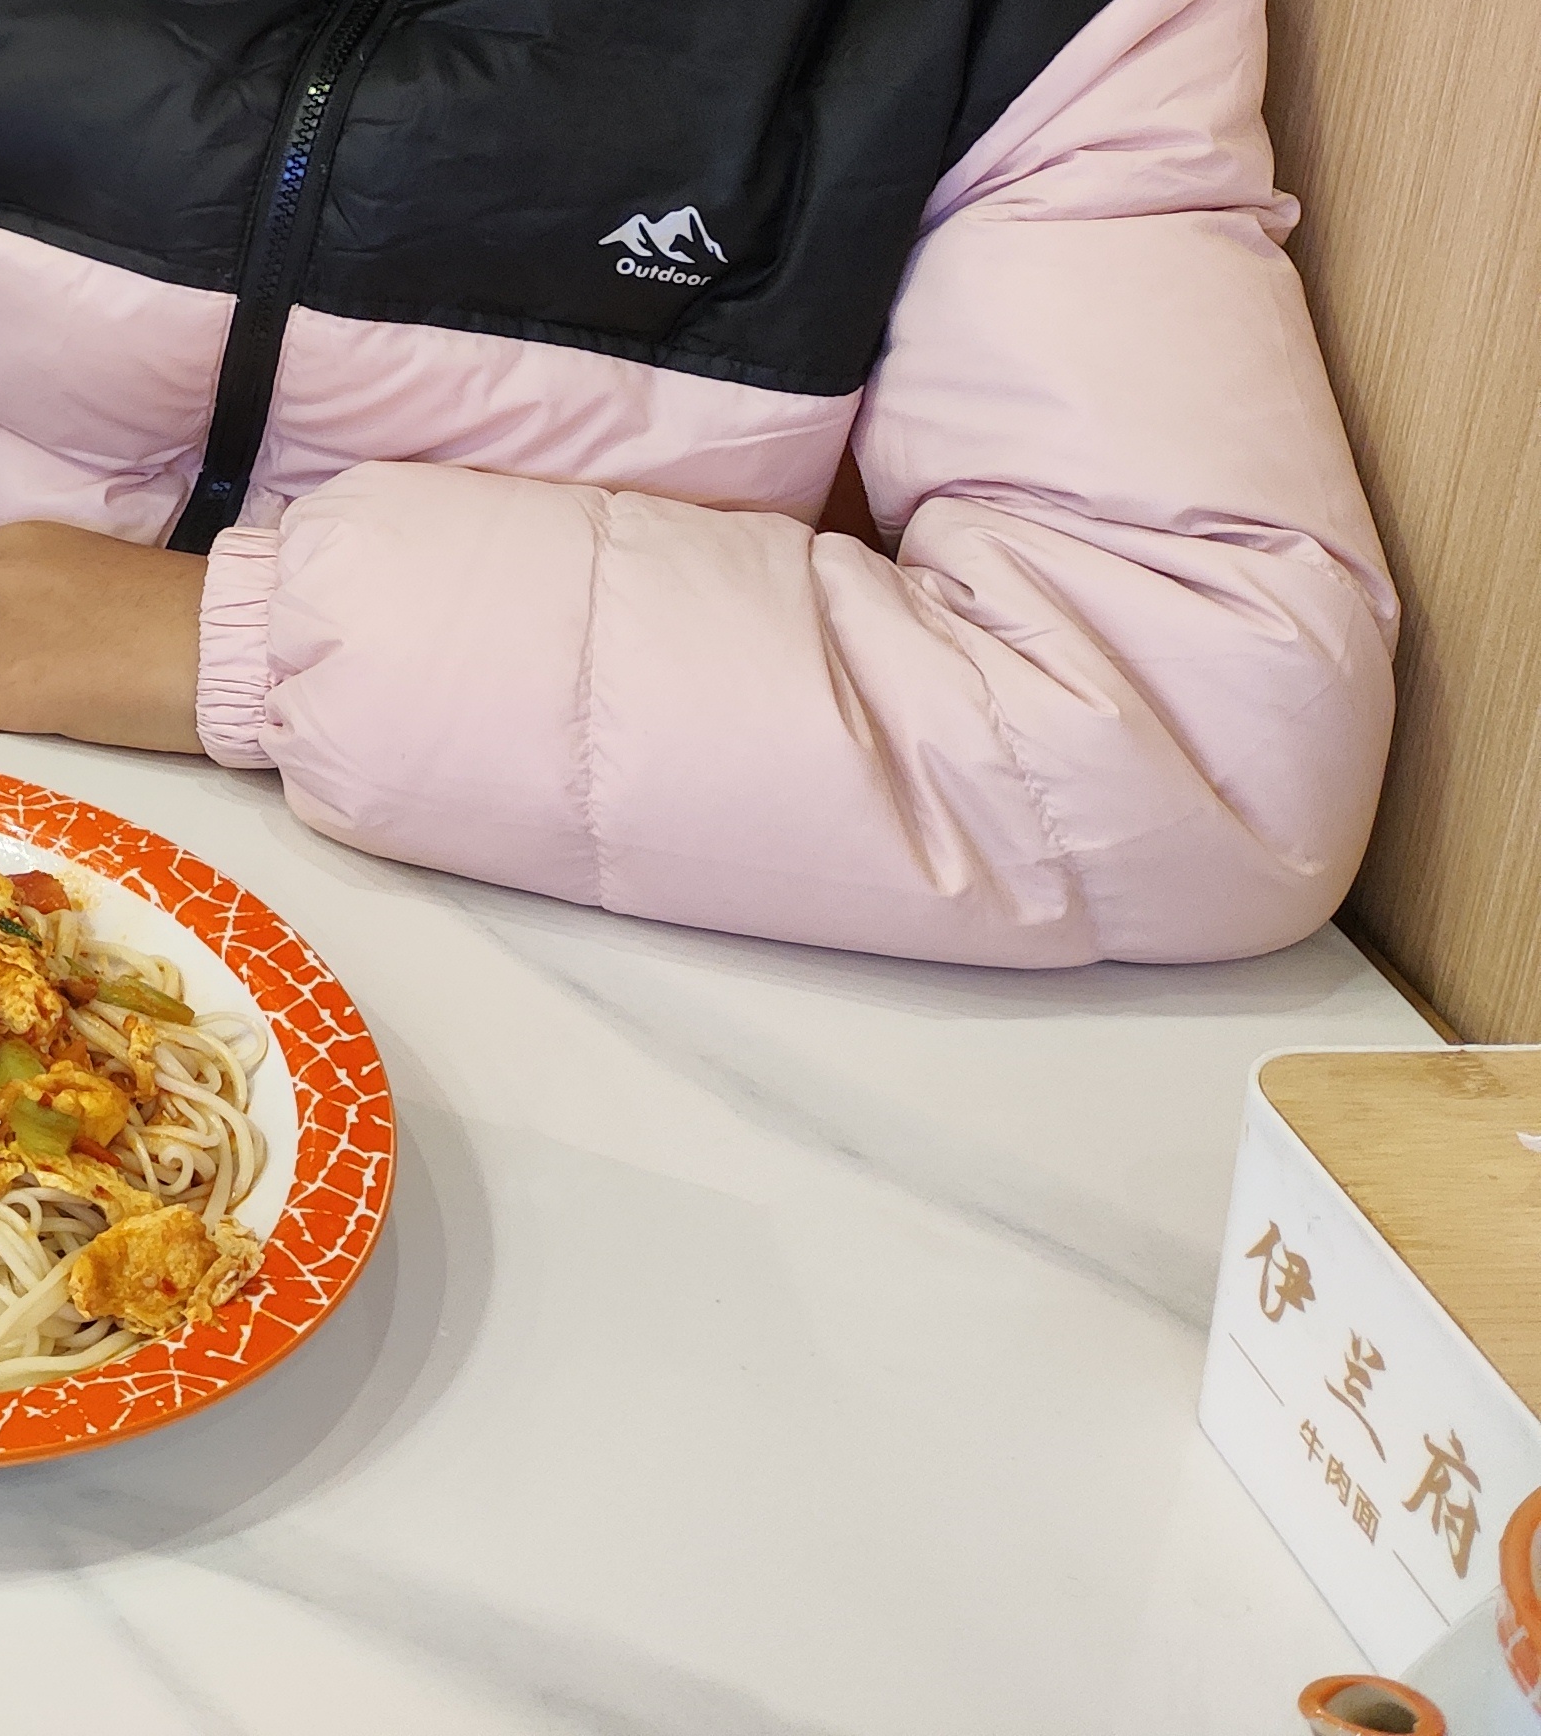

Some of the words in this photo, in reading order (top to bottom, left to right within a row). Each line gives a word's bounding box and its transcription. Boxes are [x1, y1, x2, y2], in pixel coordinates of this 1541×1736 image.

[616, 257, 712, 286] Outdoor
[1244, 1221, 1482, 1578] 伊兰府
[1299, 1420, 1380, 1545] 牛肉面
